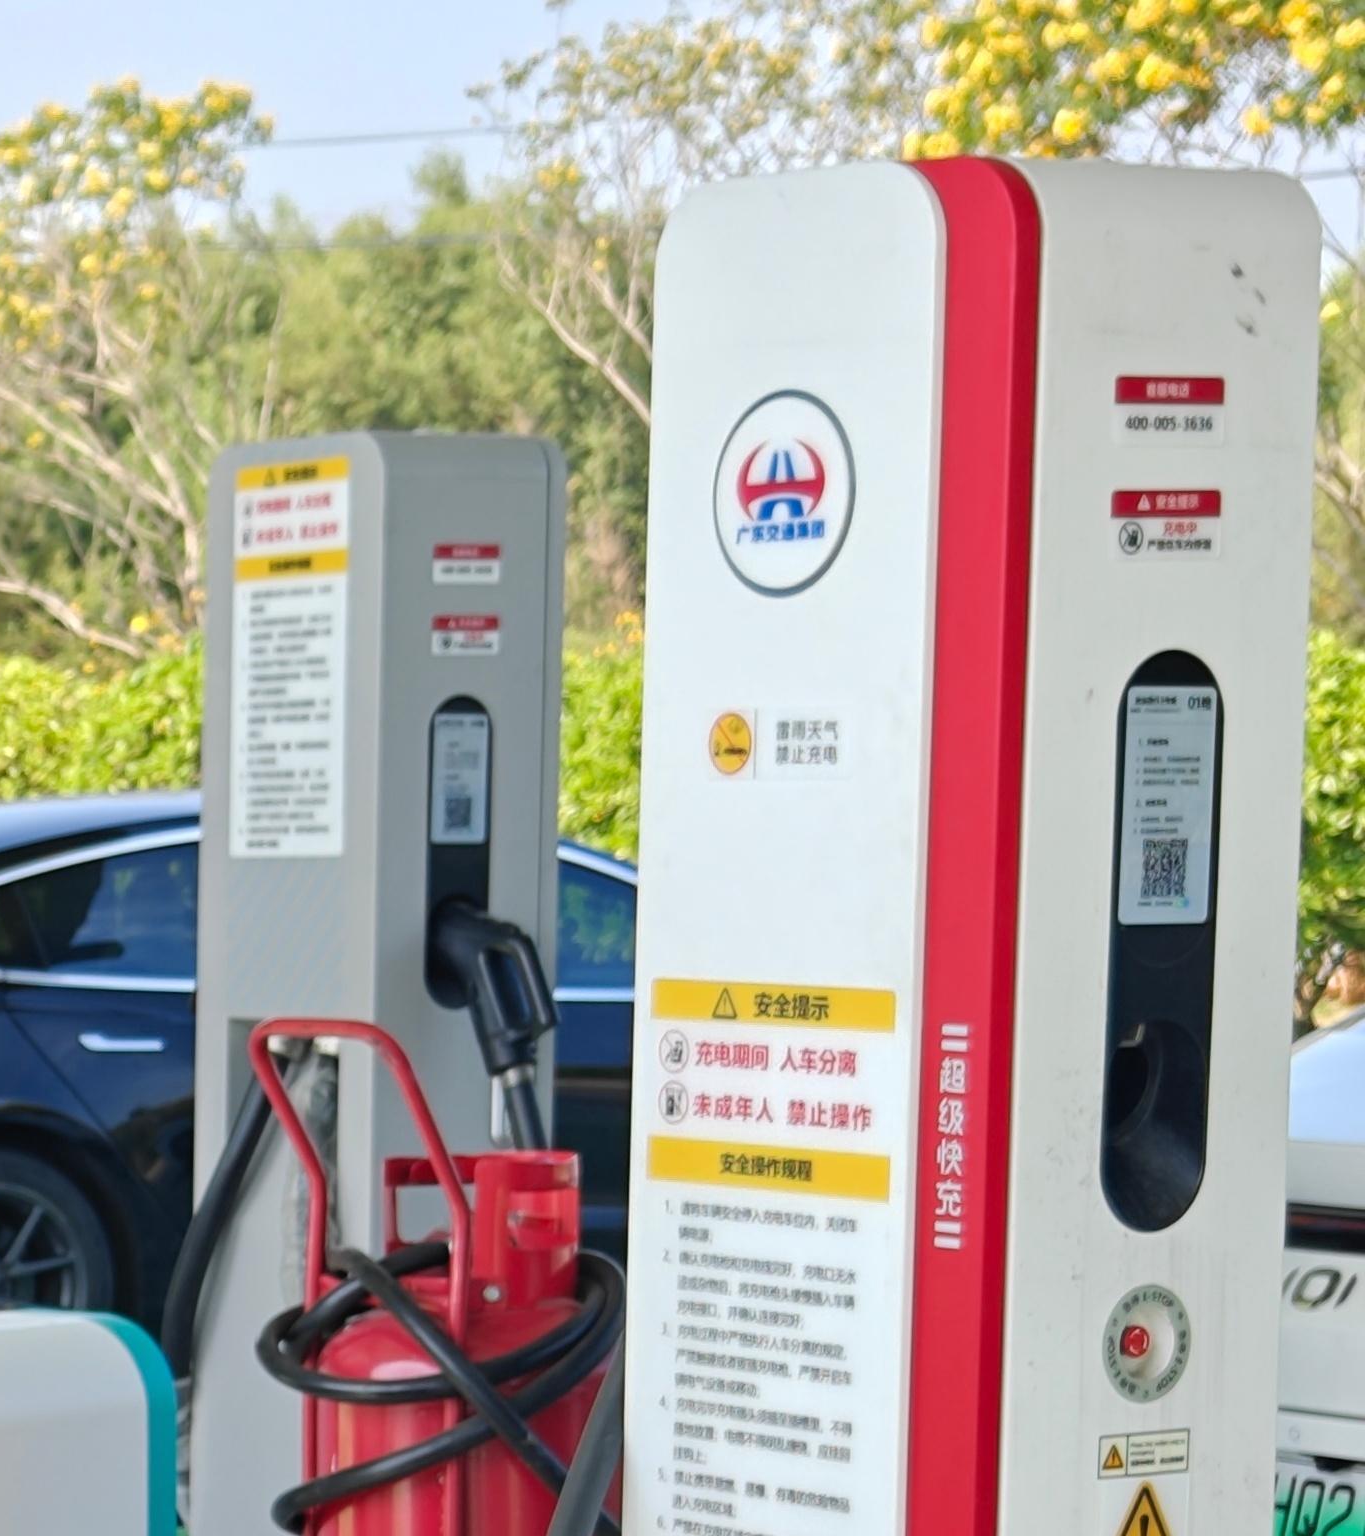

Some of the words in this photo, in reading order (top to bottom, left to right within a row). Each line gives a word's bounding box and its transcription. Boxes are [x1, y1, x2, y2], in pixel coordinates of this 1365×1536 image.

[1125, 416, 1213, 432] 400-005-3636
[735, 520, 825, 545] 广东交通集团
[775, 720, 839, 742] 雷雨天气
[775, 744, 838, 766] 禁止充电
[755, 993, 830, 1021] 安全提示
[694, 1041, 769, 1070] 充电期间
[779, 1048, 857, 1077] 人车分离
[693, 1093, 774, 1123] 未成年人
[786, 1100, 872, 1132] 禁止操作
[934, 1056, 967, 1217] 超级快充
[719, 1152, 813, 1182] 安全操作规程
